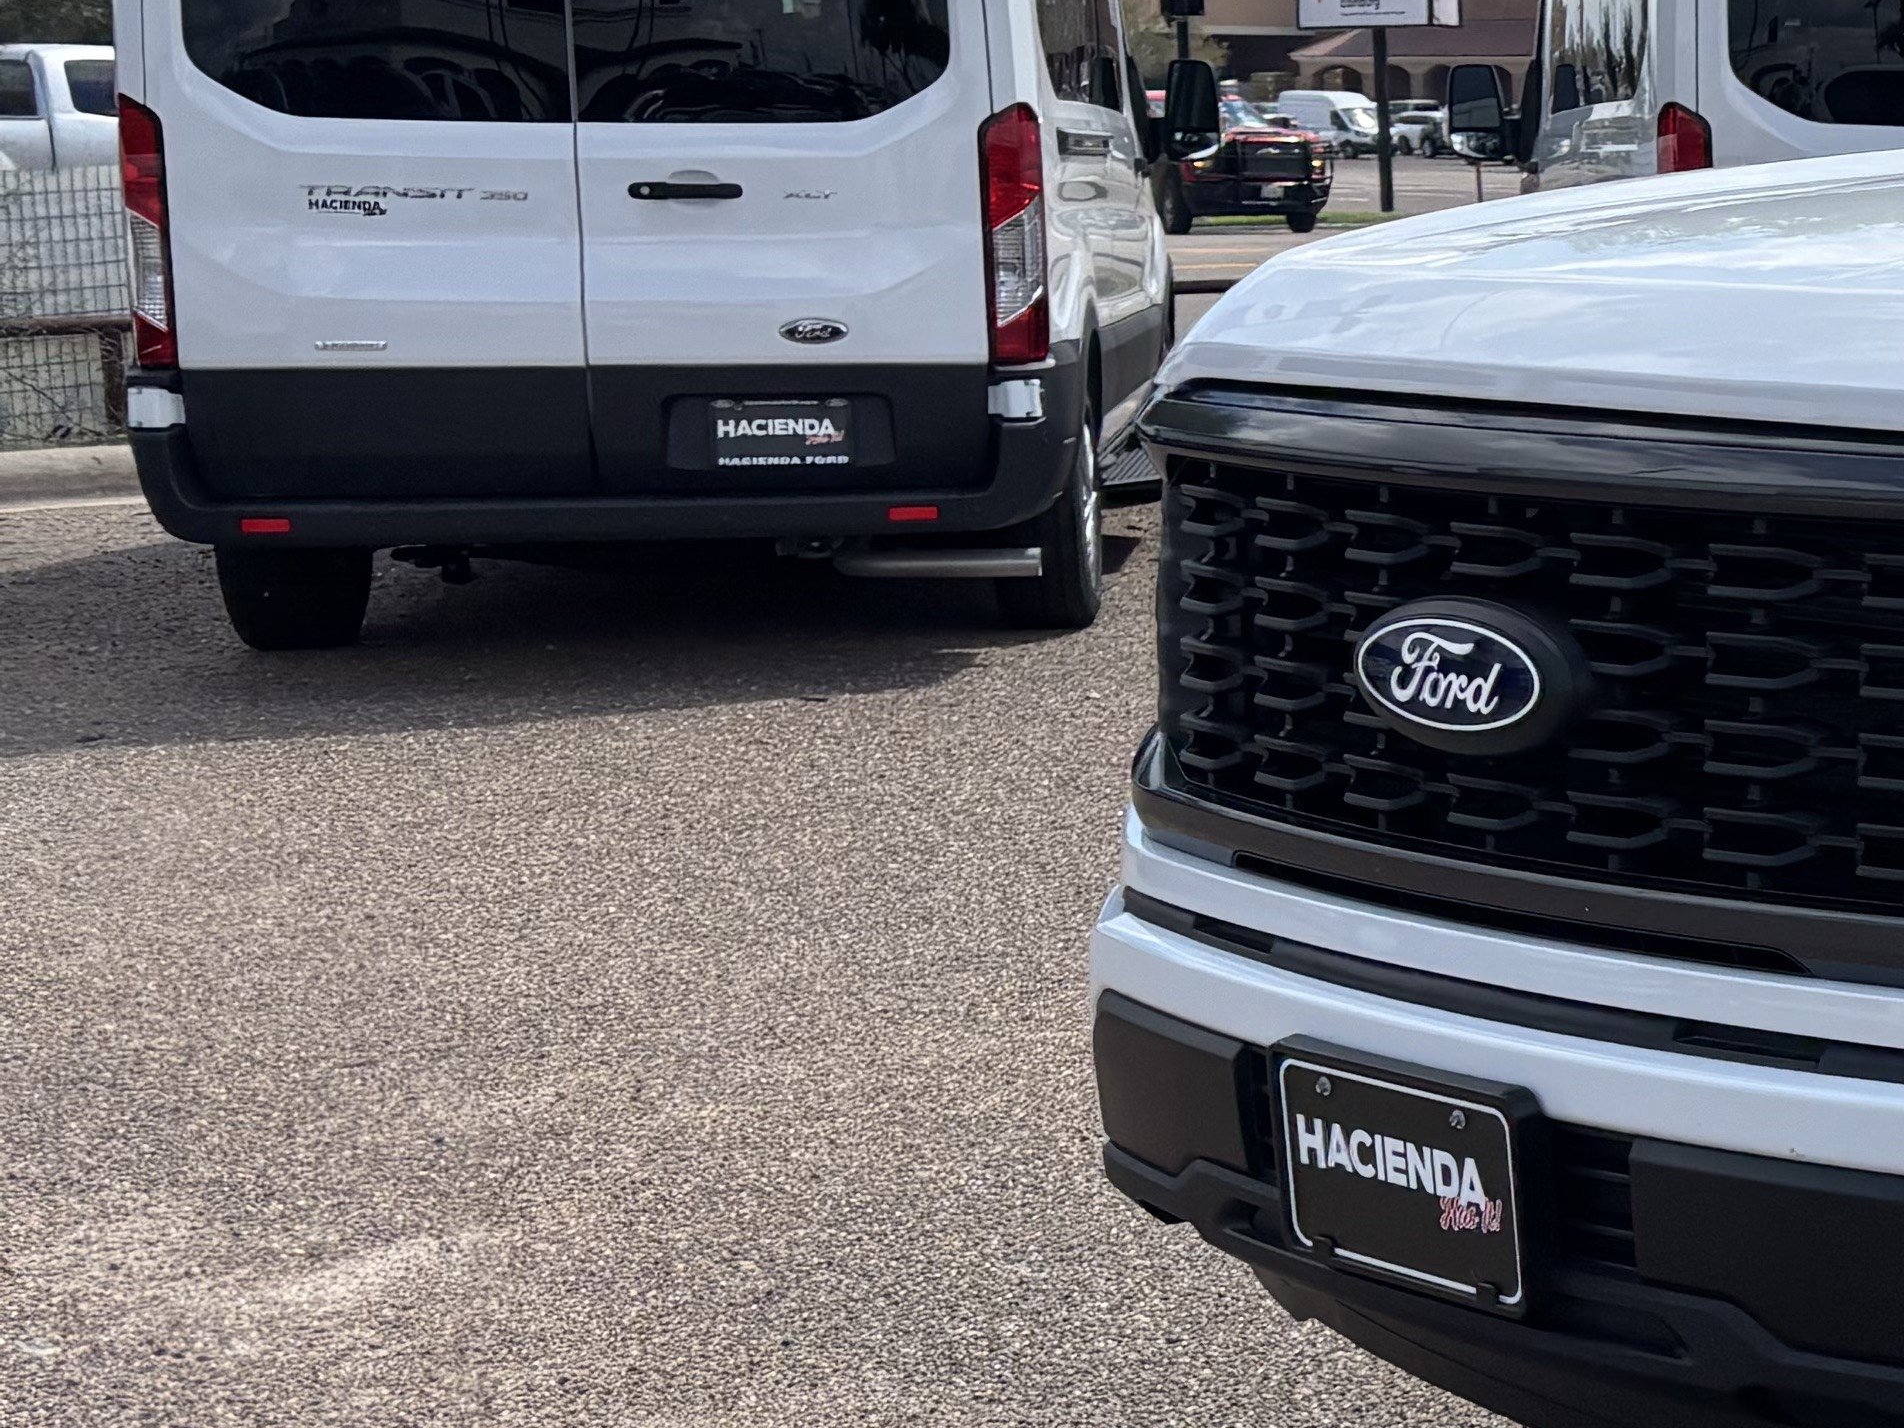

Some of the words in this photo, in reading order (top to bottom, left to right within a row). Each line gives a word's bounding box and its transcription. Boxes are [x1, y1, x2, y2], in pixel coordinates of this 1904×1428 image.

[300, 185, 474, 199] TRANSIT
[308, 199, 381, 211] HACIENDA
[717, 418, 835, 439] HACIENDA
[718, 456, 801, 466] HACIENDA
[805, 456, 850, 465] FORD
[1390, 632, 1503, 715] Ford
[1296, 1113, 1486, 1212] HACIENDA
